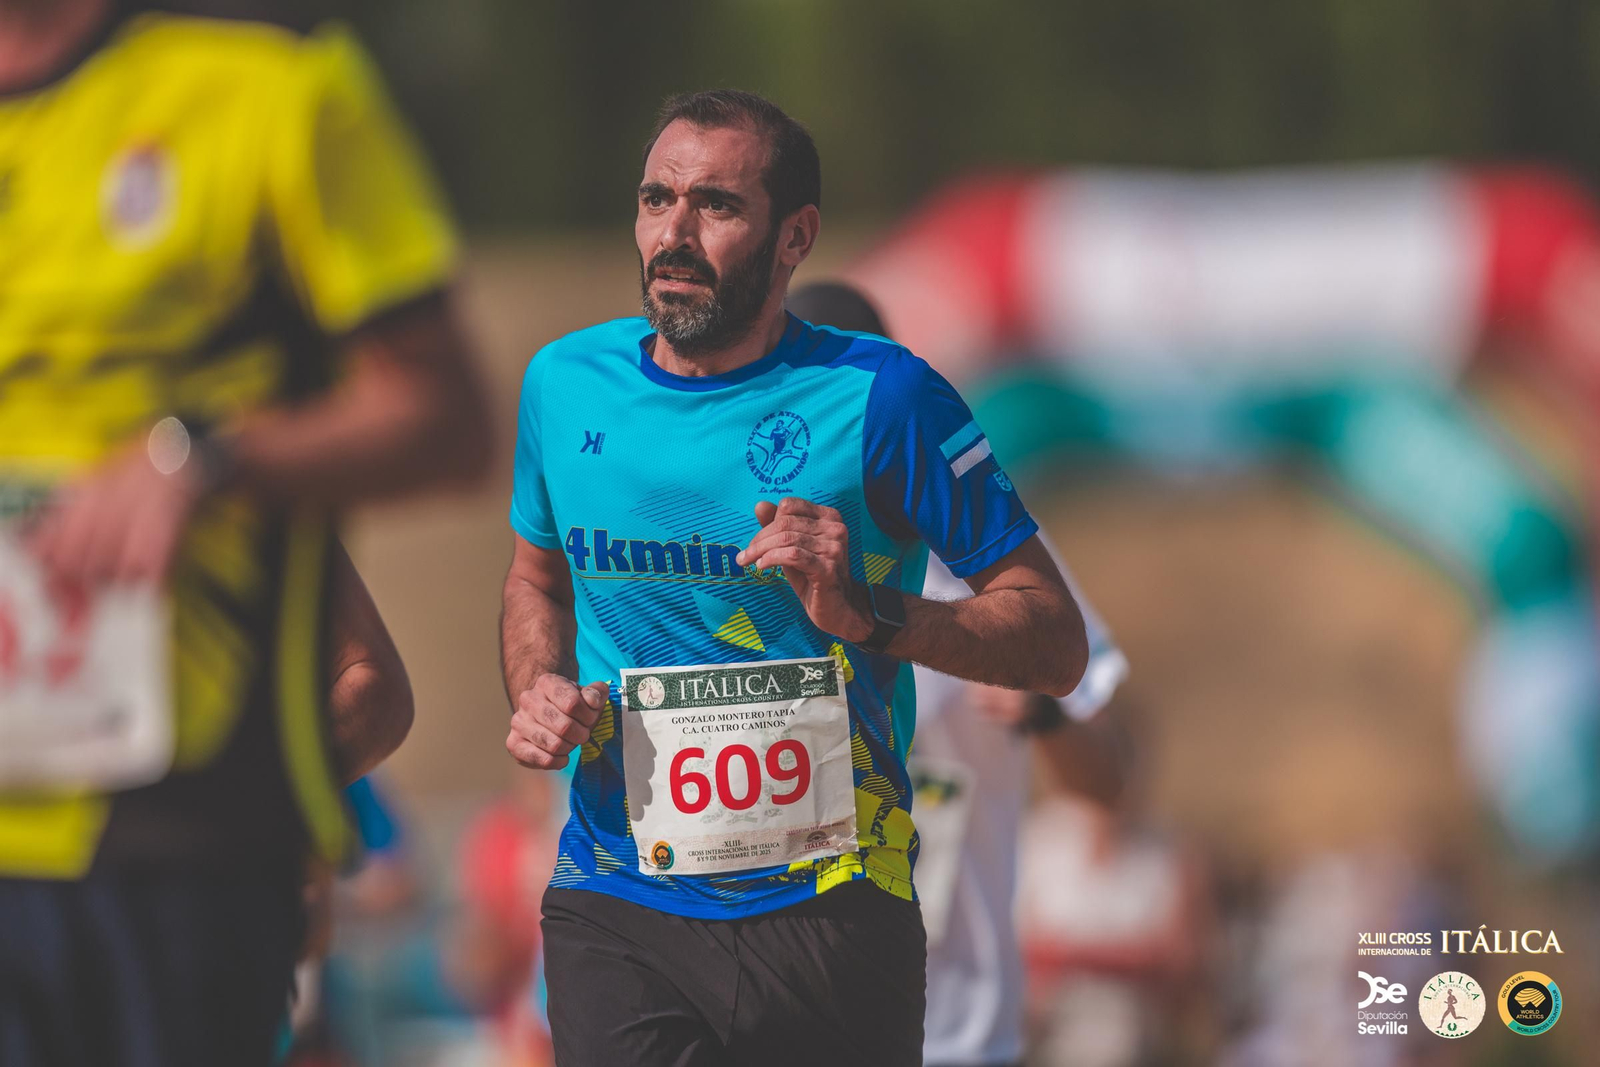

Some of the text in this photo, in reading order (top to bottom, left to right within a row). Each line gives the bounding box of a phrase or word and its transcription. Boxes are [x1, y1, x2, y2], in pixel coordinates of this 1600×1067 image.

[746, 450, 809, 486] CUATRO CAMINOS
[565, 526, 772, 582] 4kmin
[679, 672, 783, 701] ITÁLICA
[680, 699, 730, 707] INTERNATIONAL
[753, 694, 784, 702] COUNTRY
[671, 708, 796, 725] GONZALO MONTERO TAPIA
[682, 719, 786, 735] C.A. CUATRO CAMINOS
[669, 739, 812, 814] 609
[705, 846, 749, 856] INTERNACIONAL
[718, 852, 750, 861] NOVIEMBRE
